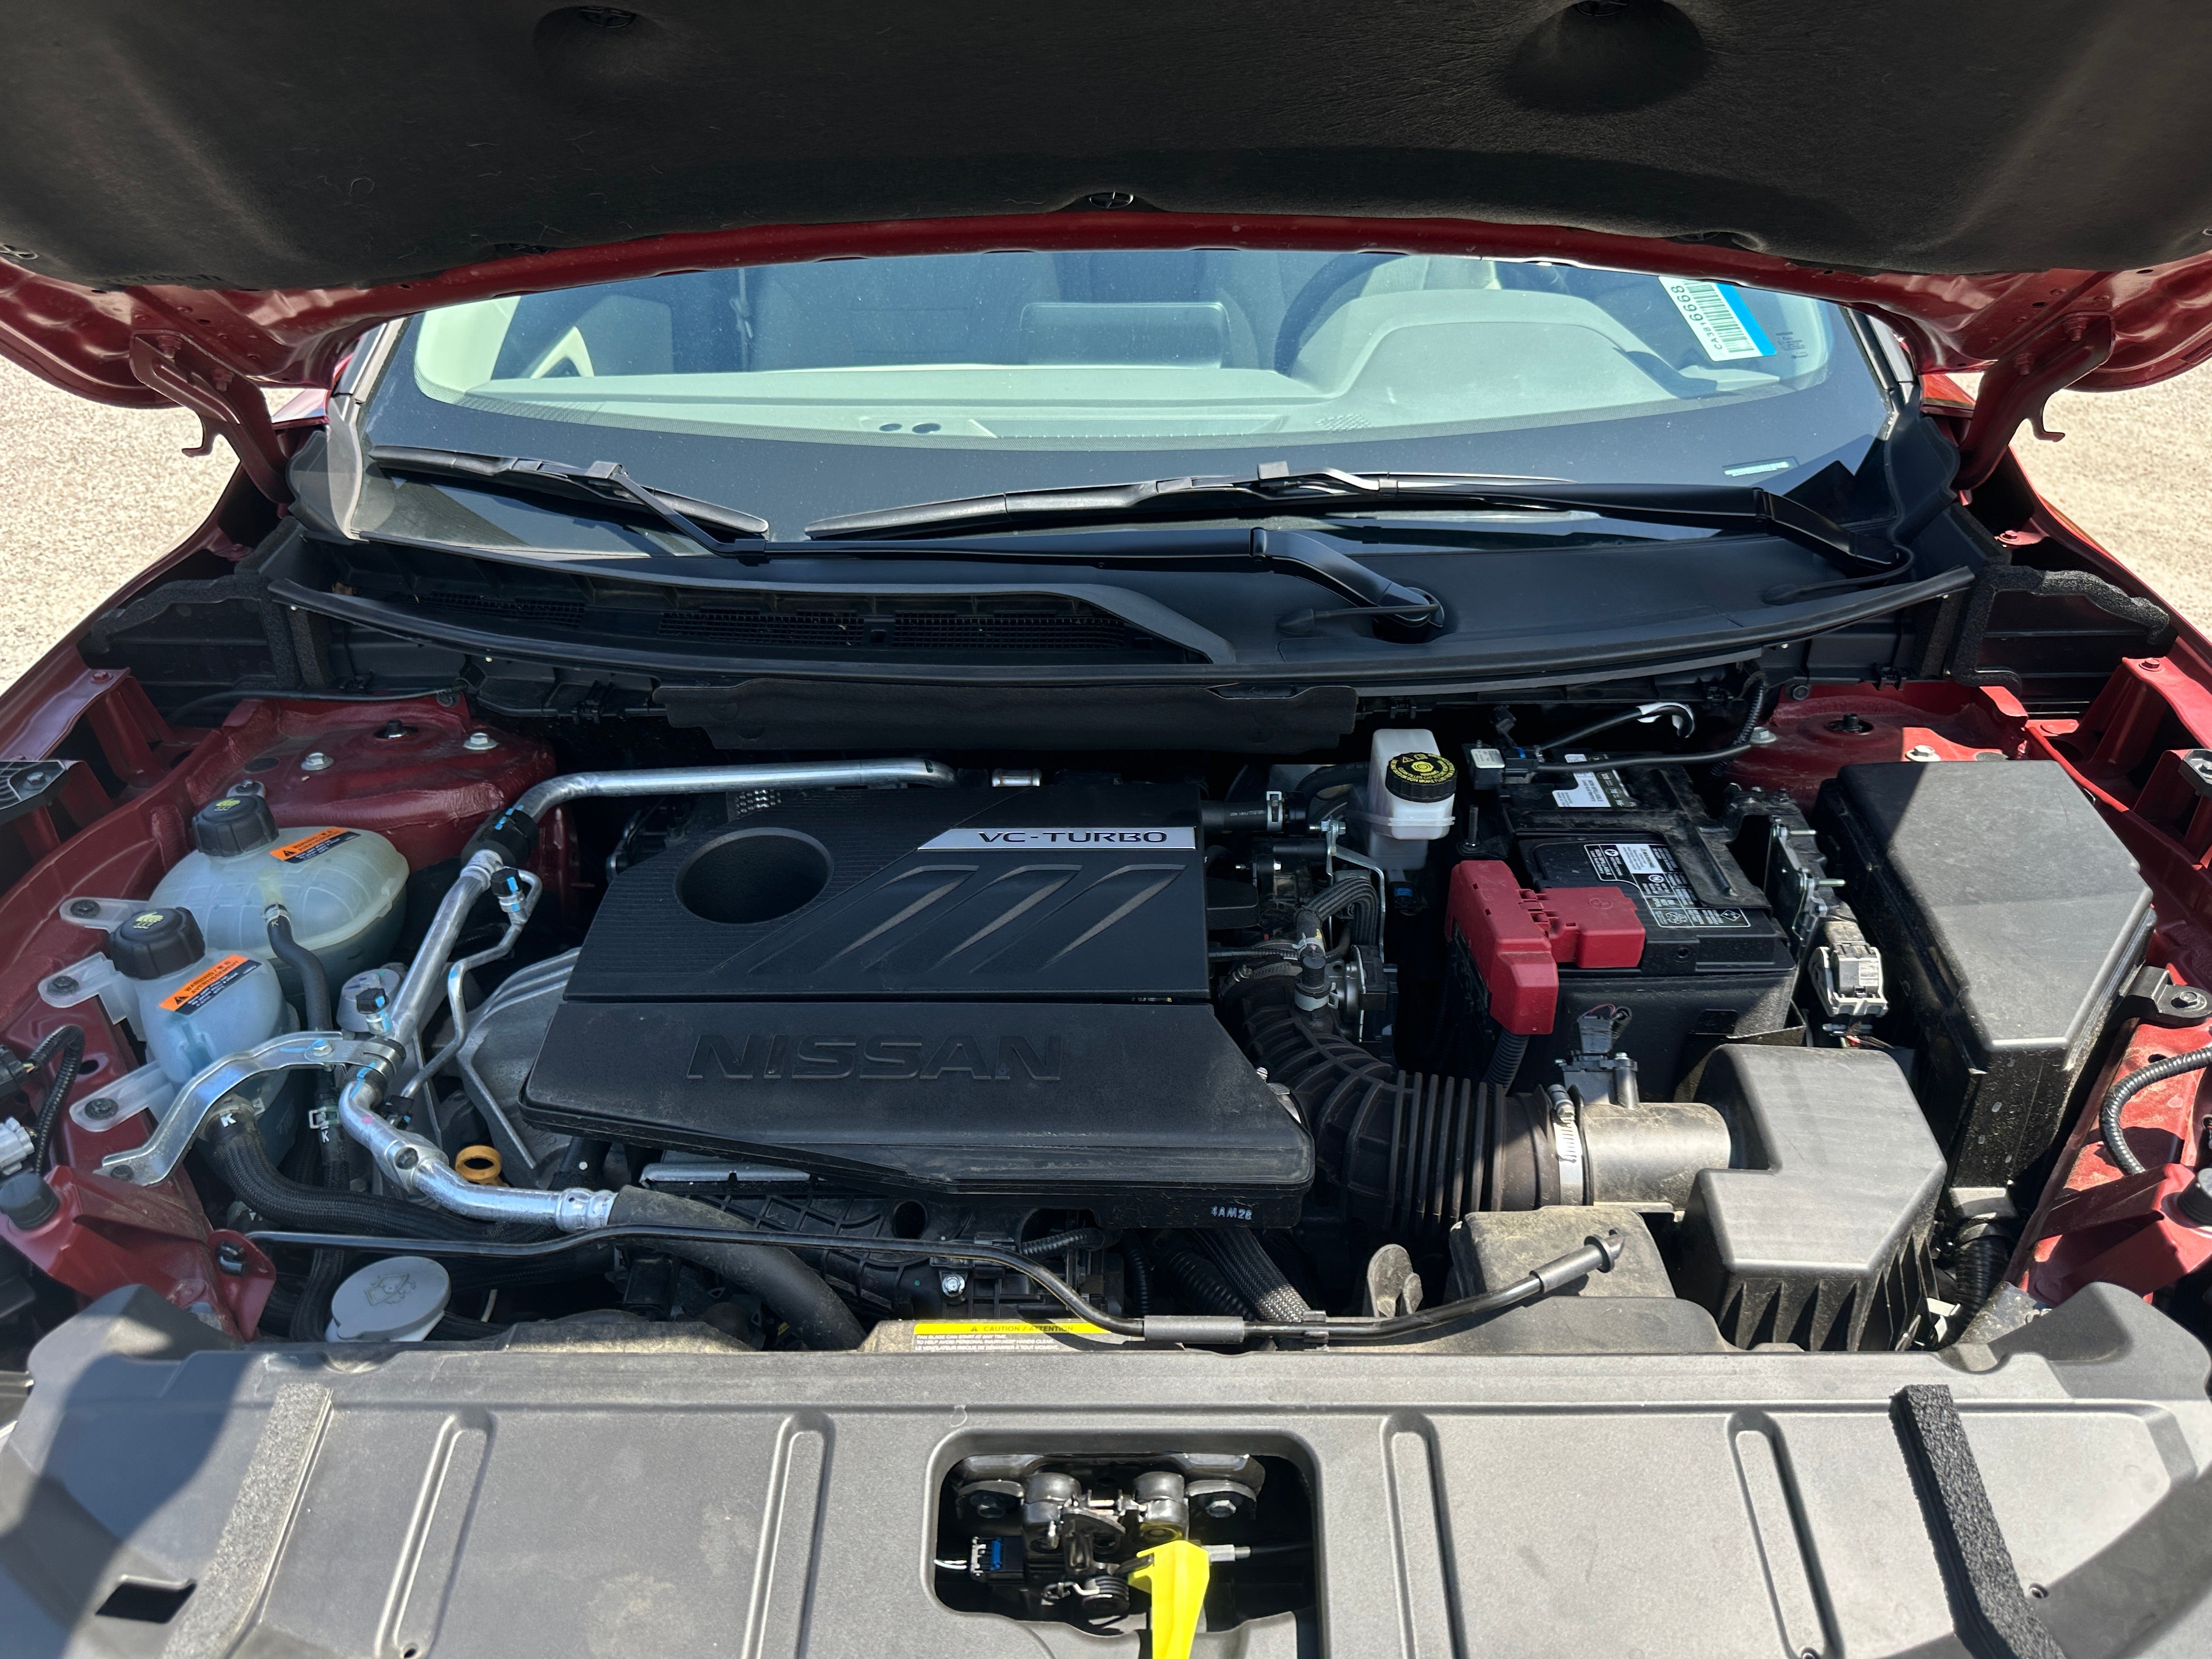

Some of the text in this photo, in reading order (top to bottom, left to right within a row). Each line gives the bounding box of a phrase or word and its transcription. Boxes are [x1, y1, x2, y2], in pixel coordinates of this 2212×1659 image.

[977, 831, 1167, 843] VC-TURBO
[184, 971, 216, 992] WARNING
[190, 961, 240, 994] AVERTISSEMENT
[686, 1035, 1063, 1081] NISSAN
[221, 1113, 237, 1127] K
[321, 1130, 329, 1143] K
